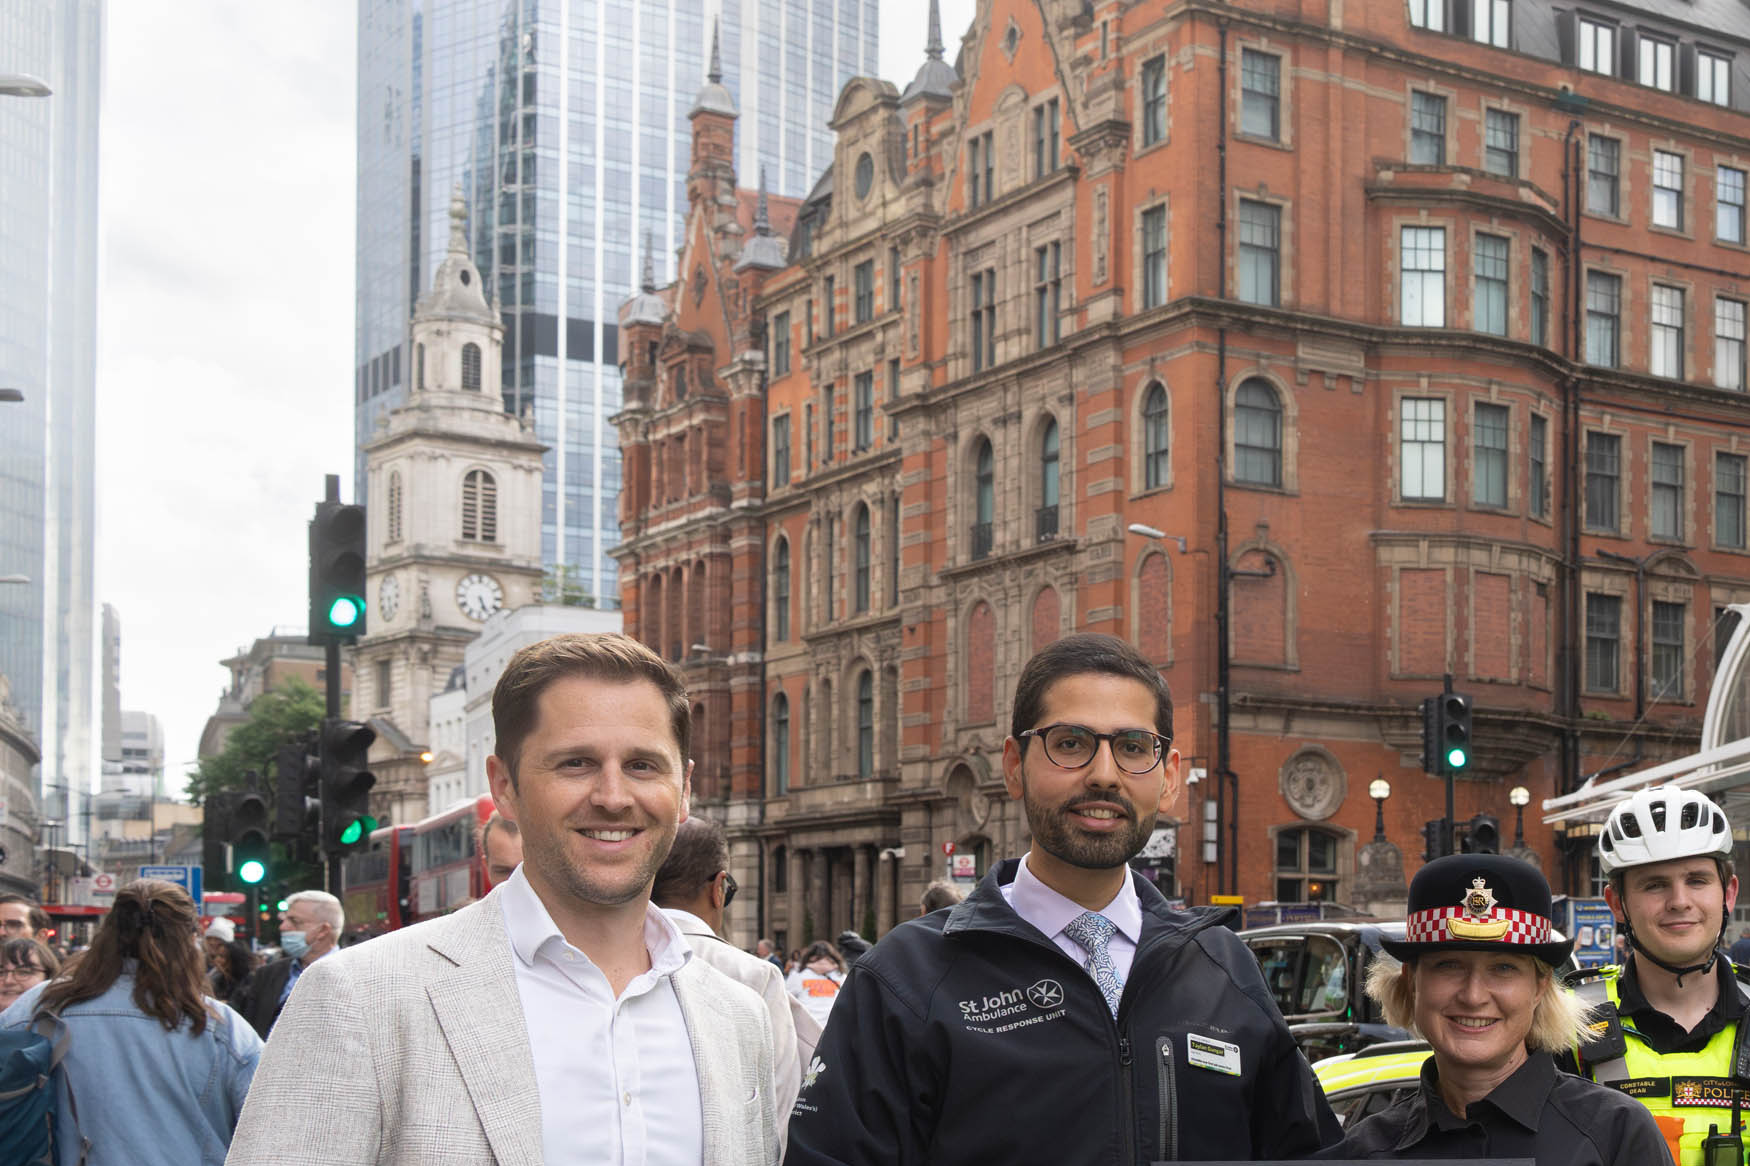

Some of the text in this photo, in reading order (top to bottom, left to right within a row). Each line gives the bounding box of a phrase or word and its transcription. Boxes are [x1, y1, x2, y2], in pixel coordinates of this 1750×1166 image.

[959, 988, 1024, 1014] St John
[963, 1003, 1028, 1022] Ambulance
[996, 1015, 1045, 1034] RESPONSE
[1045, 1009, 1067, 1021] UNIT
[1619, 1081, 1656, 1090] CONSTABLE
